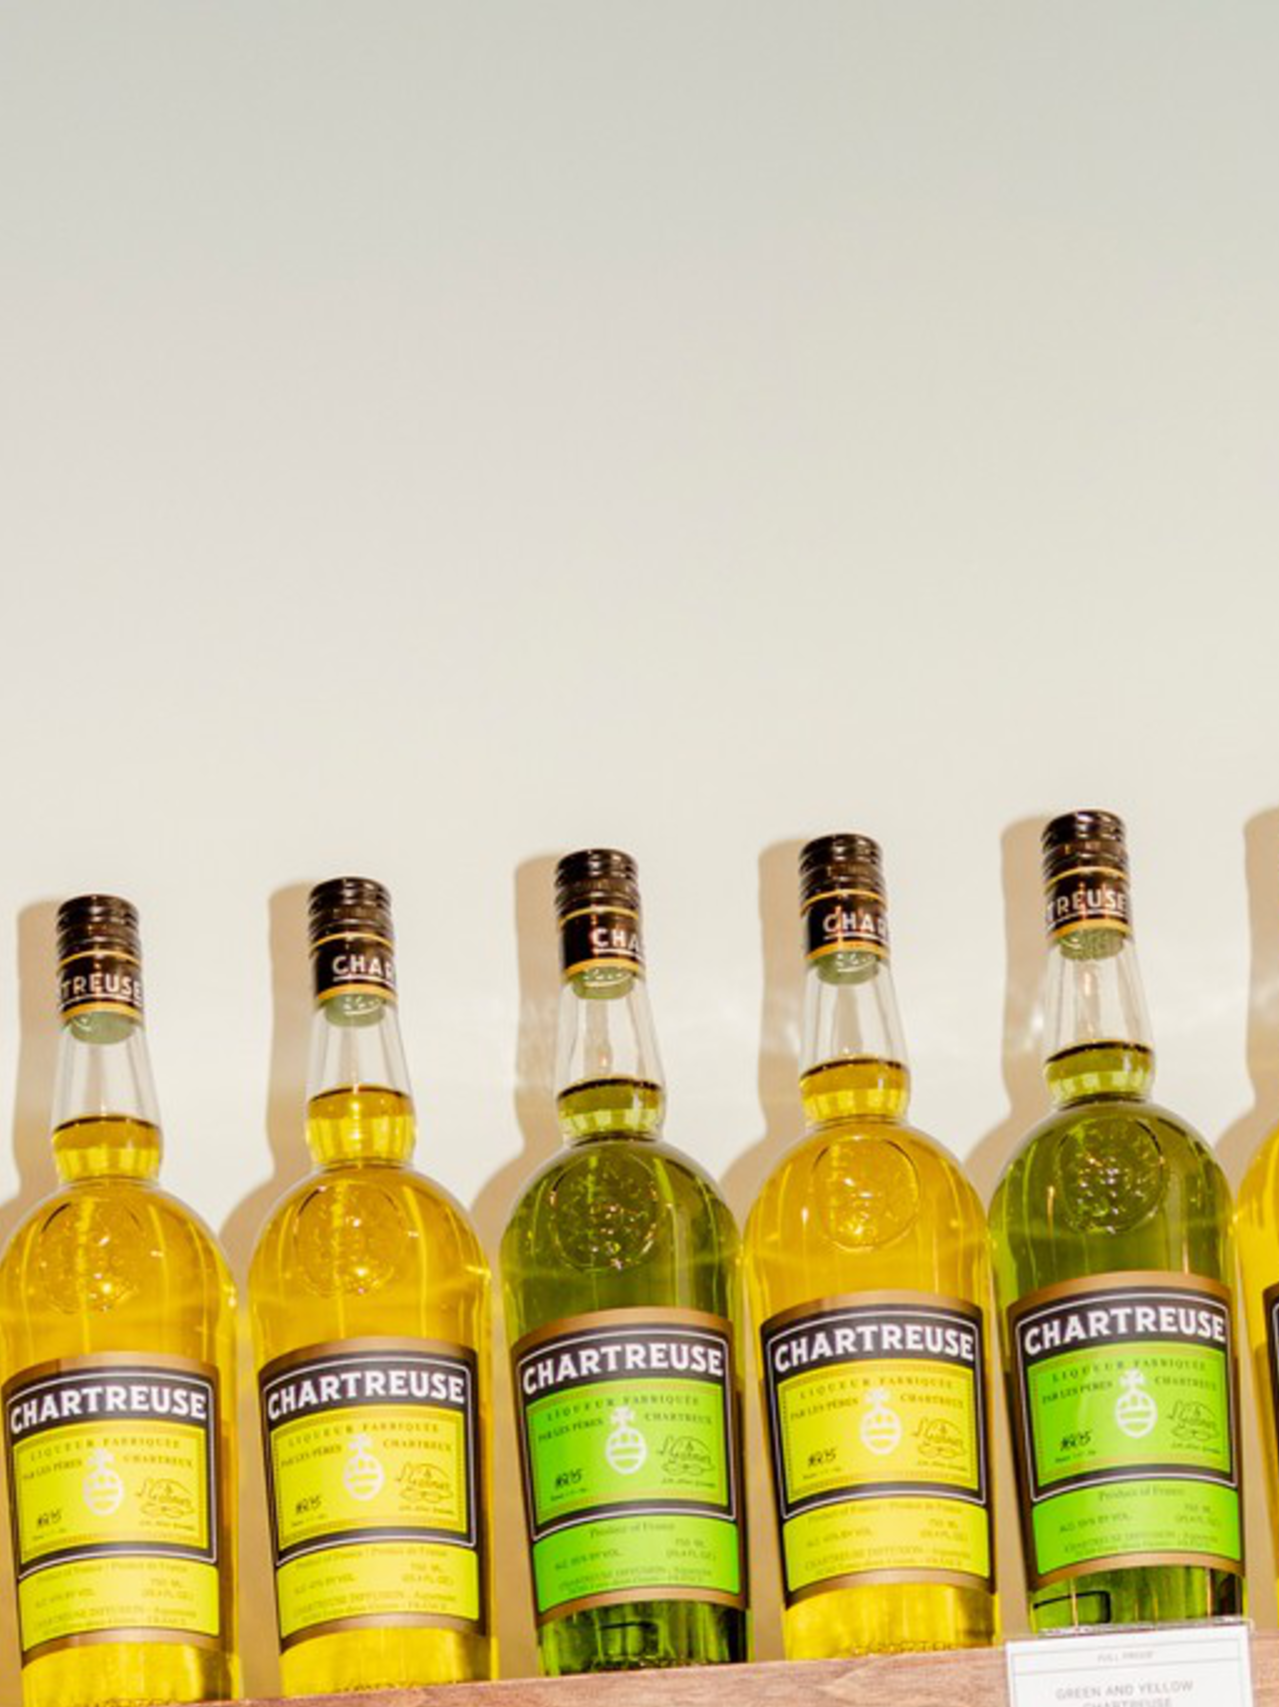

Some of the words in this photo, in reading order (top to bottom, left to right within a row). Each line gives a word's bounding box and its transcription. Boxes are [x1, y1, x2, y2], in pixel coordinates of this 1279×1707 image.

[775, 1324, 974, 1372] CHARTREUSE
[1025, 1307, 1226, 1355] CHARTREUSE
[523, 1343, 723, 1394] CHARTREUSE
[11, 1386, 207, 1434] CHARTREUSE
[268, 1370, 465, 1420] CHARTREUSE
